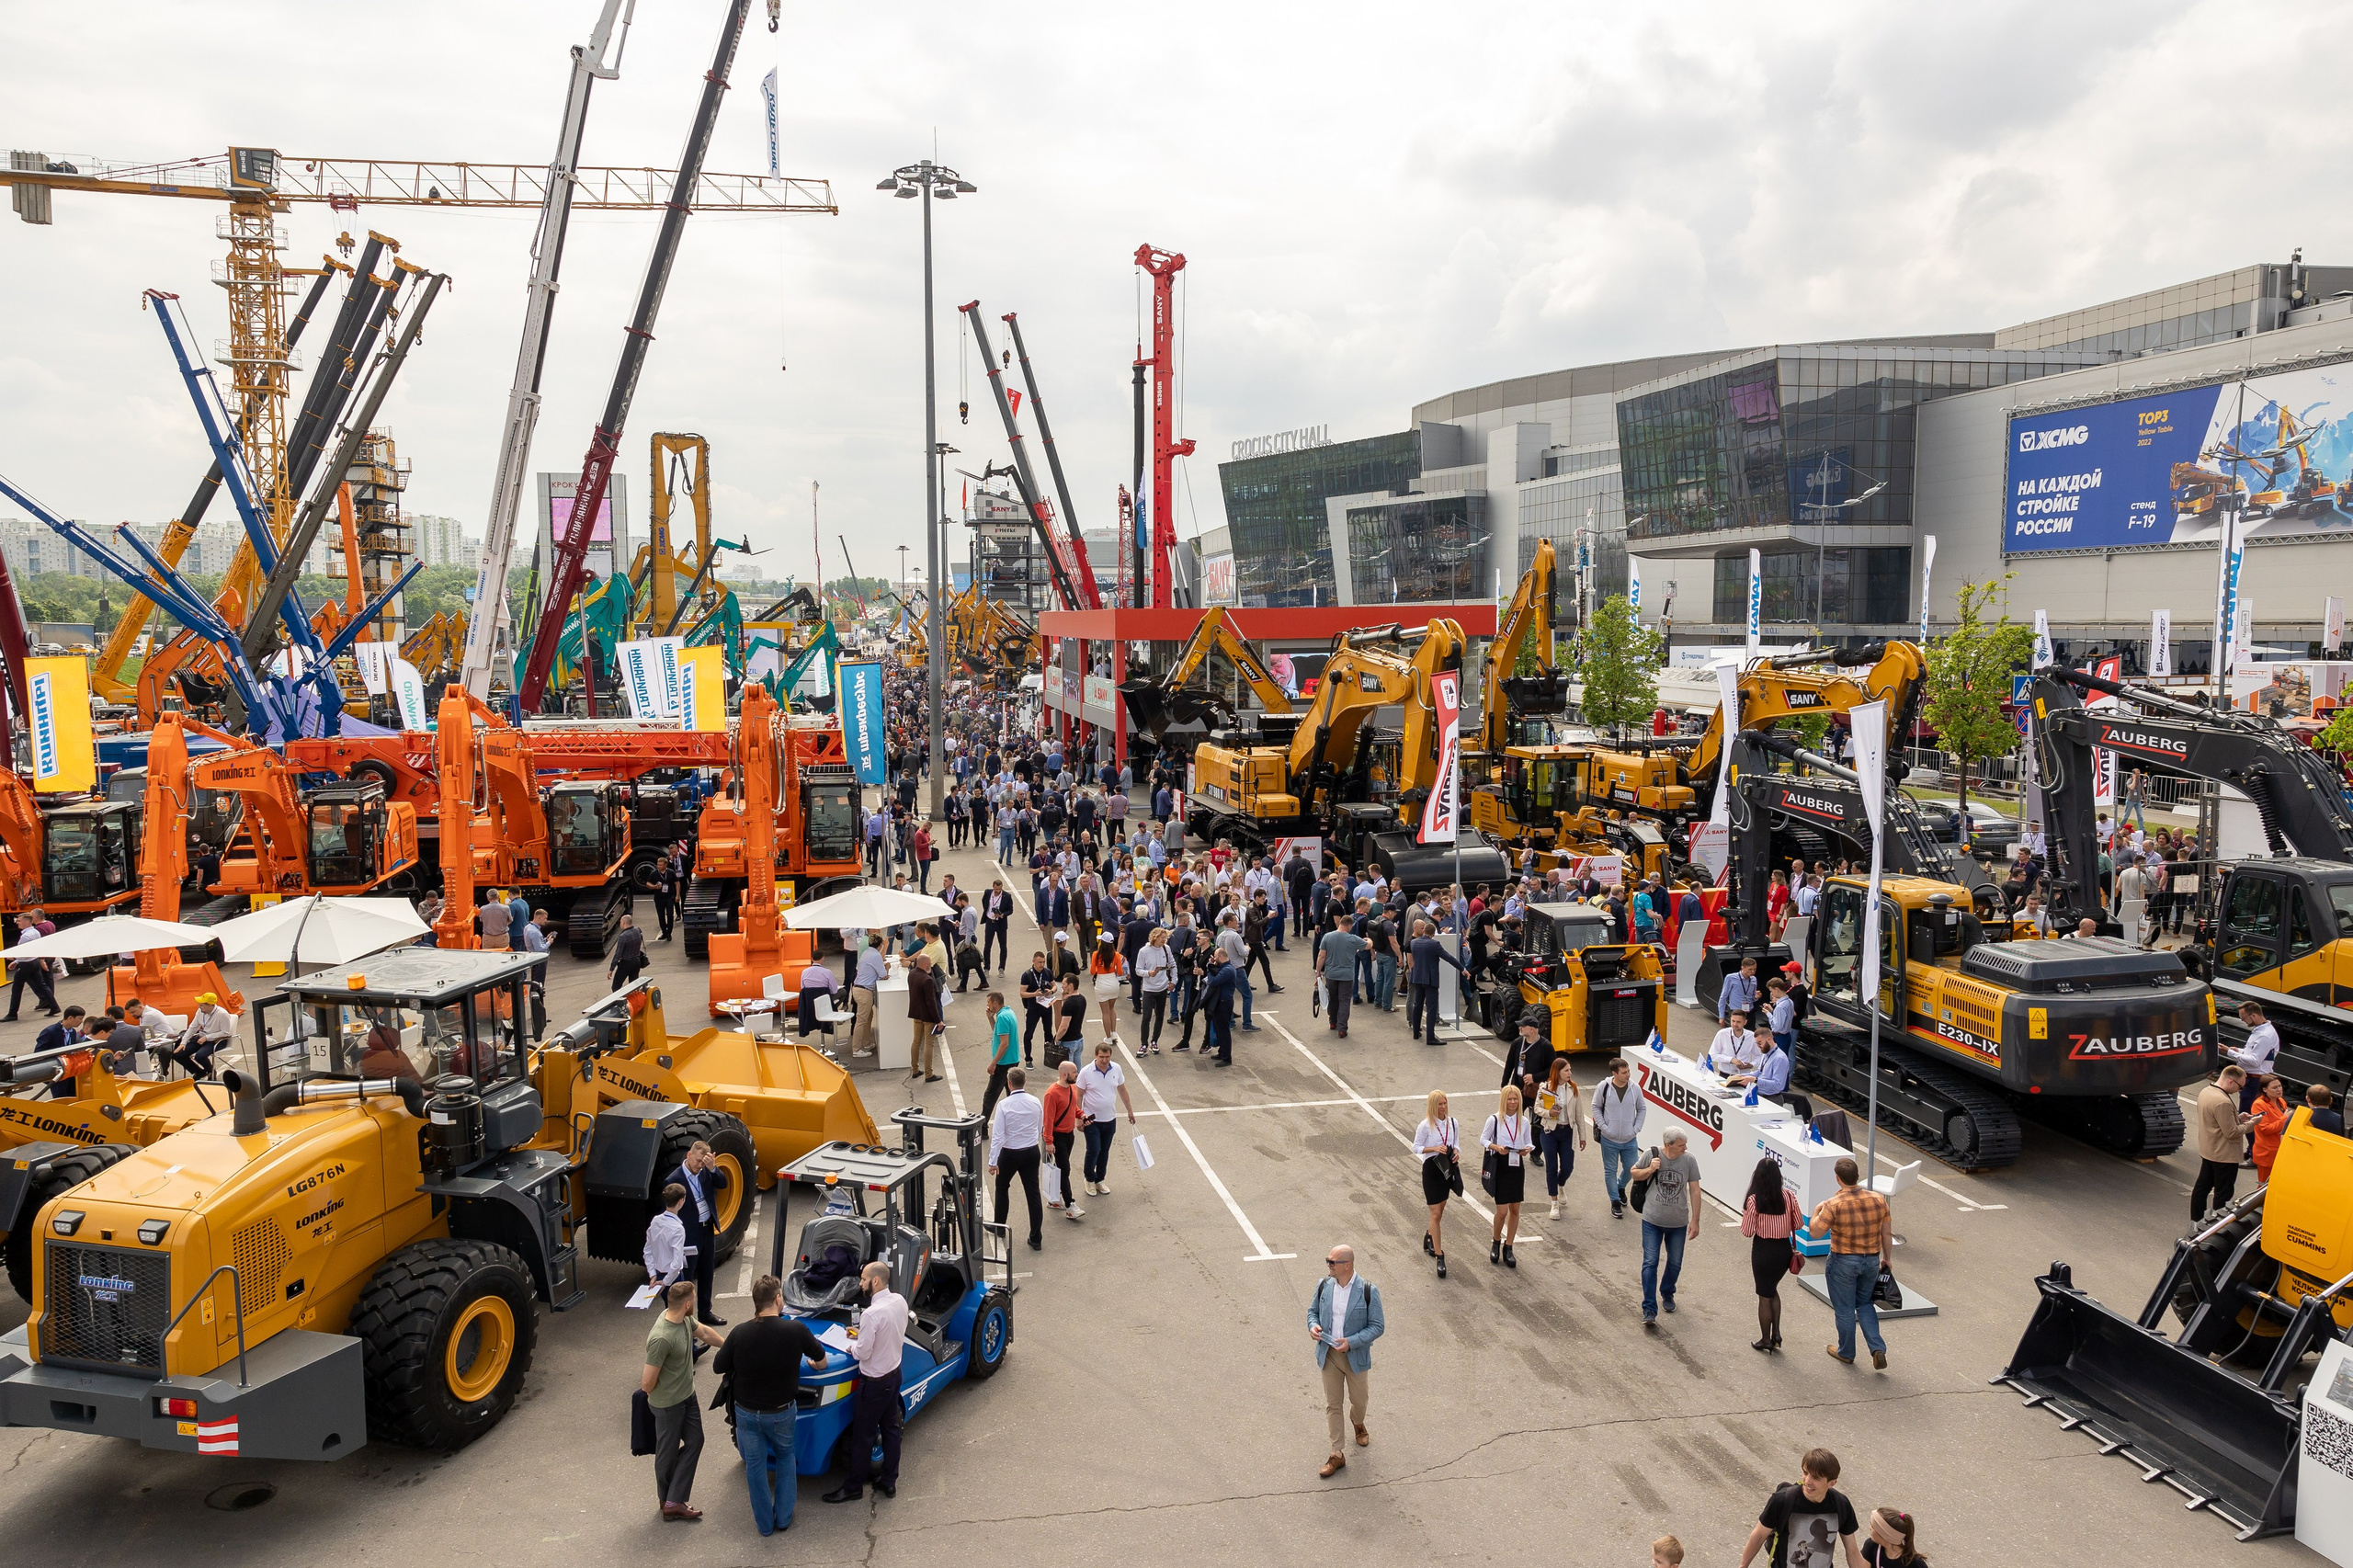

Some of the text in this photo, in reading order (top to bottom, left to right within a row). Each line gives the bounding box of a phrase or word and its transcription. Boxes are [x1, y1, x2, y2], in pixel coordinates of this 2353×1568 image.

[2138, 410, 2169, 426] TOP3
[1232, 424, 1332, 460] CROCUS CITY HALL
[2034, 426, 2088, 450] XCMG
[2138, 425, 2174, 437] Yellow Table
[2137, 438, 2152, 447] 2022
[2018, 468, 2102, 496] НА КАЖДОЙ
[2017, 494, 2080, 516] СТРОЙКЕ
[2131, 501, 2156, 511] стенд
[2015, 517, 2074, 535] РОССИИ
[2128, 515, 2156, 529] F-19
[1208, 559, 1232, 591] SANY
[1751, 573, 1760, 636] KAMAZ
[2219, 547, 2243, 643] KAMAZ
[559, 613, 590, 639] SUNWAD
[688, 623, 715, 648] SUNWARD
[1240, 662, 1258, 681] SANY
[1362, 676, 1378, 688] SANY
[1790, 692, 1818, 707] SANY
[2099, 724, 2188, 756] ZAUBERG
[212, 763, 243, 781] LONKING
[1780, 790, 1844, 818] ZAUBERG
[1606, 825, 1622, 836] SANY
[1613, 989, 1637, 997] ZAUBERG
[313, 1045, 326, 1056] 15
[2068, 1028, 2203, 1059] ZAUBERG
[1637, 1062, 1723, 1134] ZAUBERG
[32, 1116, 107, 1145] LONKING
[287, 1163, 346, 1198] LG876N
[296, 1198, 345, 1230] LONKING
[2287, 1234, 2326, 1255] CUMMINS
[79, 1275, 134, 1291] LONKING
